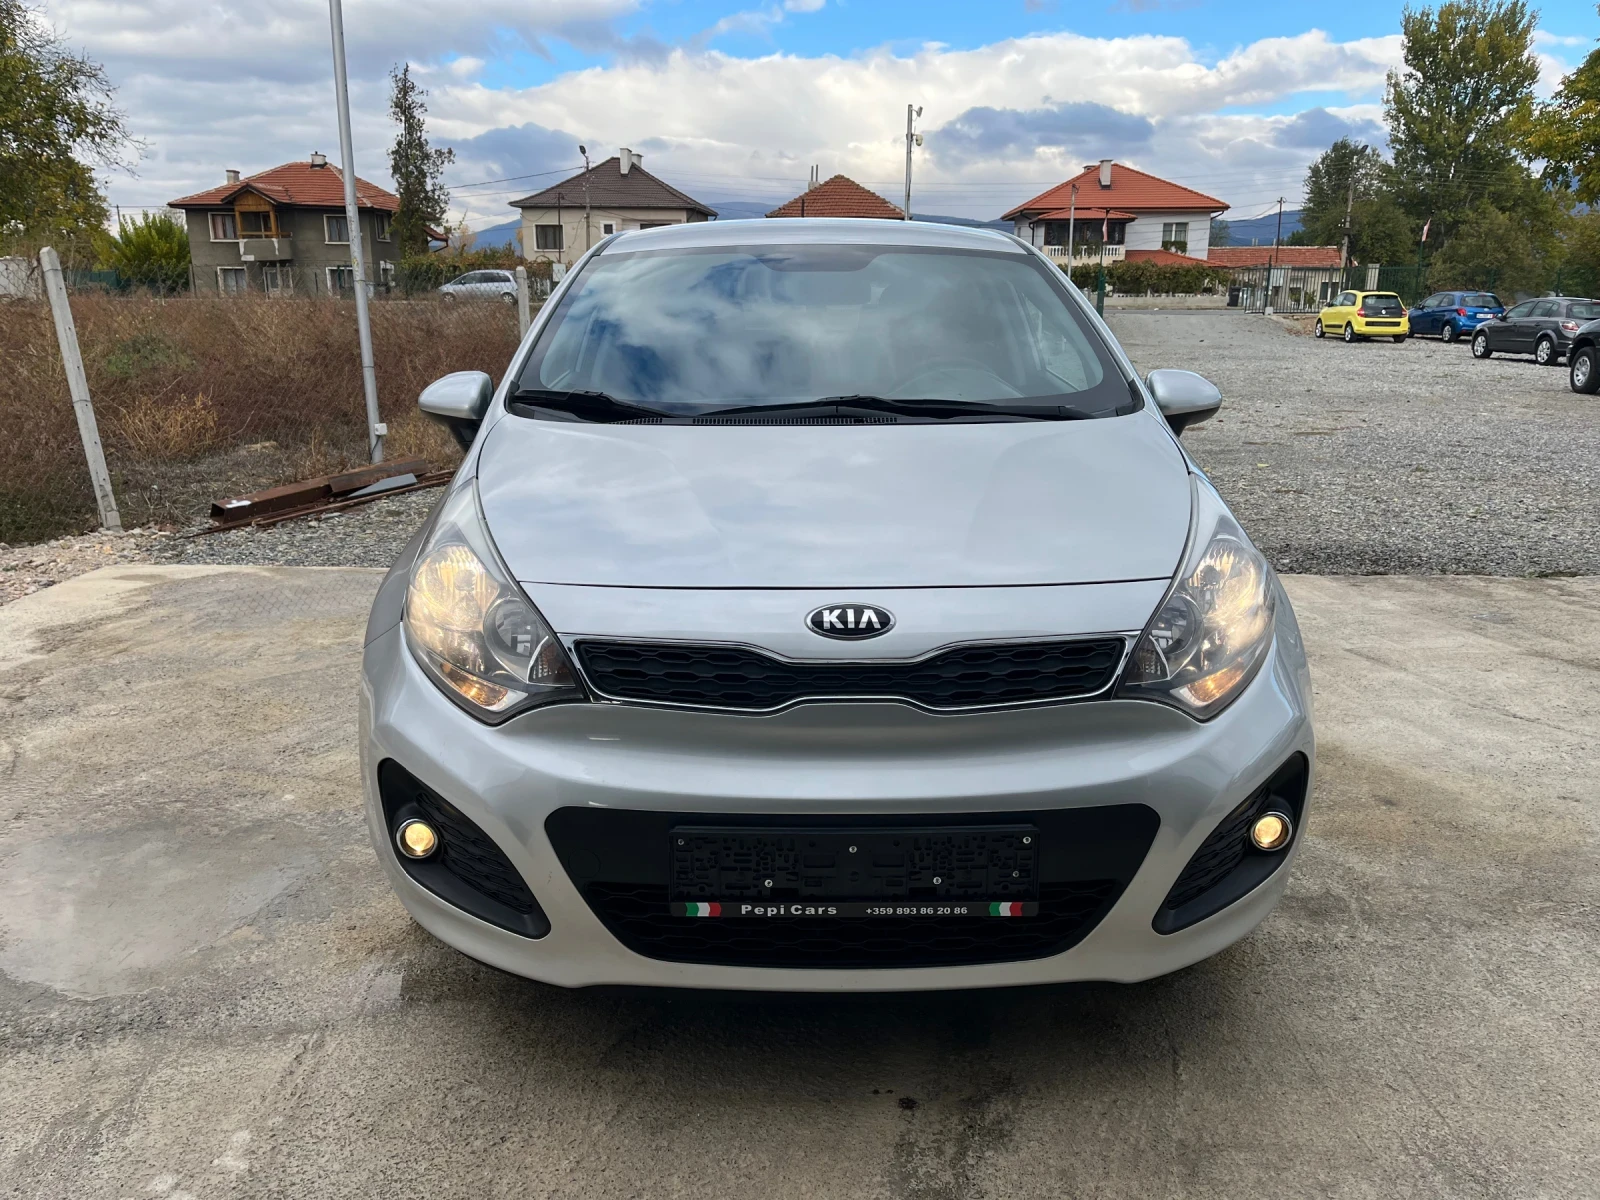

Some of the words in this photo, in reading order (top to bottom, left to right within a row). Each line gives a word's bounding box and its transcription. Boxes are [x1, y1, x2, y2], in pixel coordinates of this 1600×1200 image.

[822, 608, 881, 630] KIA
[741, 904, 785, 917] Pepi
[790, 904, 837, 915] Cars
[865, 907, 893, 915] +359
[896, 907, 917, 915] 893
[920, 907, 934, 915] 86
[937, 906, 951, 915] 20
[953, 906, 968, 915] 86
